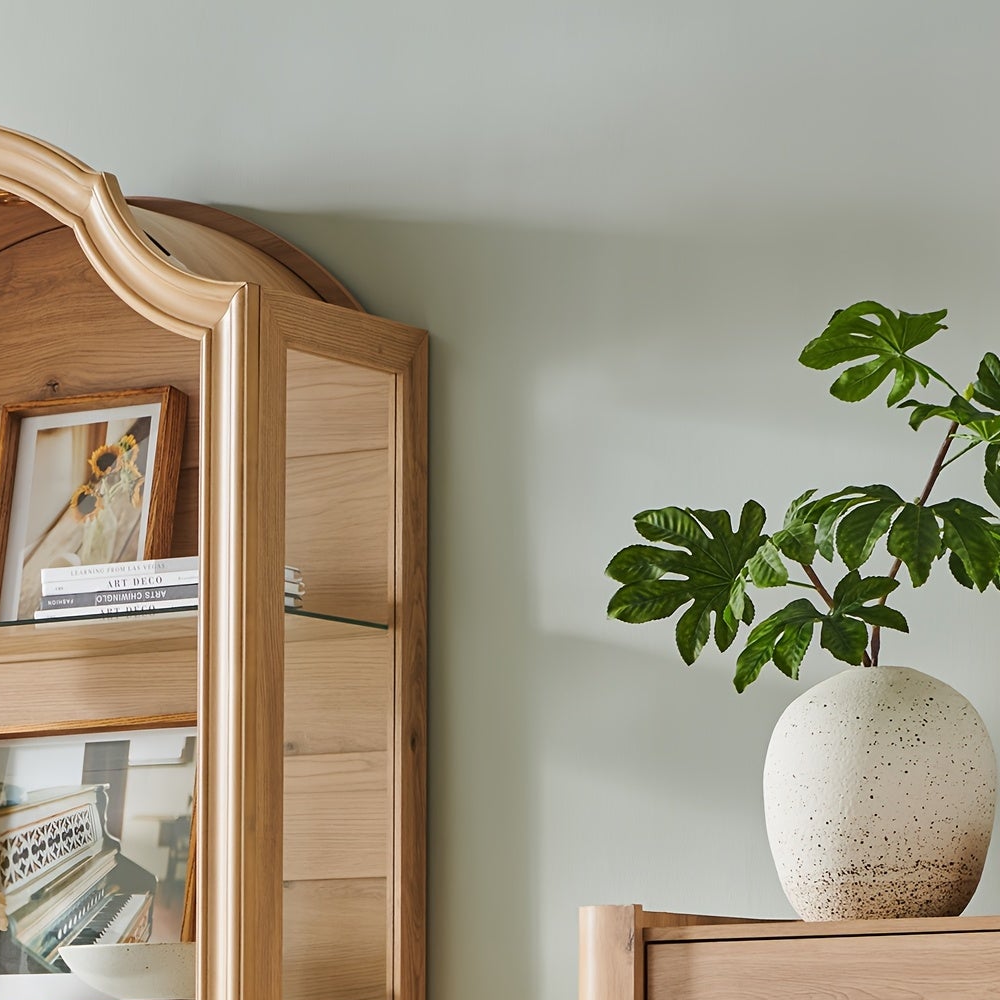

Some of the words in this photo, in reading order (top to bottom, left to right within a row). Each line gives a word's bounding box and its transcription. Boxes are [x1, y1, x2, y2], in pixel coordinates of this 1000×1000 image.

[70, 568, 105, 576] LEARNING
[107, 565, 126, 573] FROM
[143, 563, 166, 571] VEGAS
[108, 577, 128, 588] ART
[133, 575, 163, 586] DECO
[96, 591, 143, 603] CHIWINGLO
[145, 590, 167, 599] ARTS
[47, 598, 75, 606] FASHION
